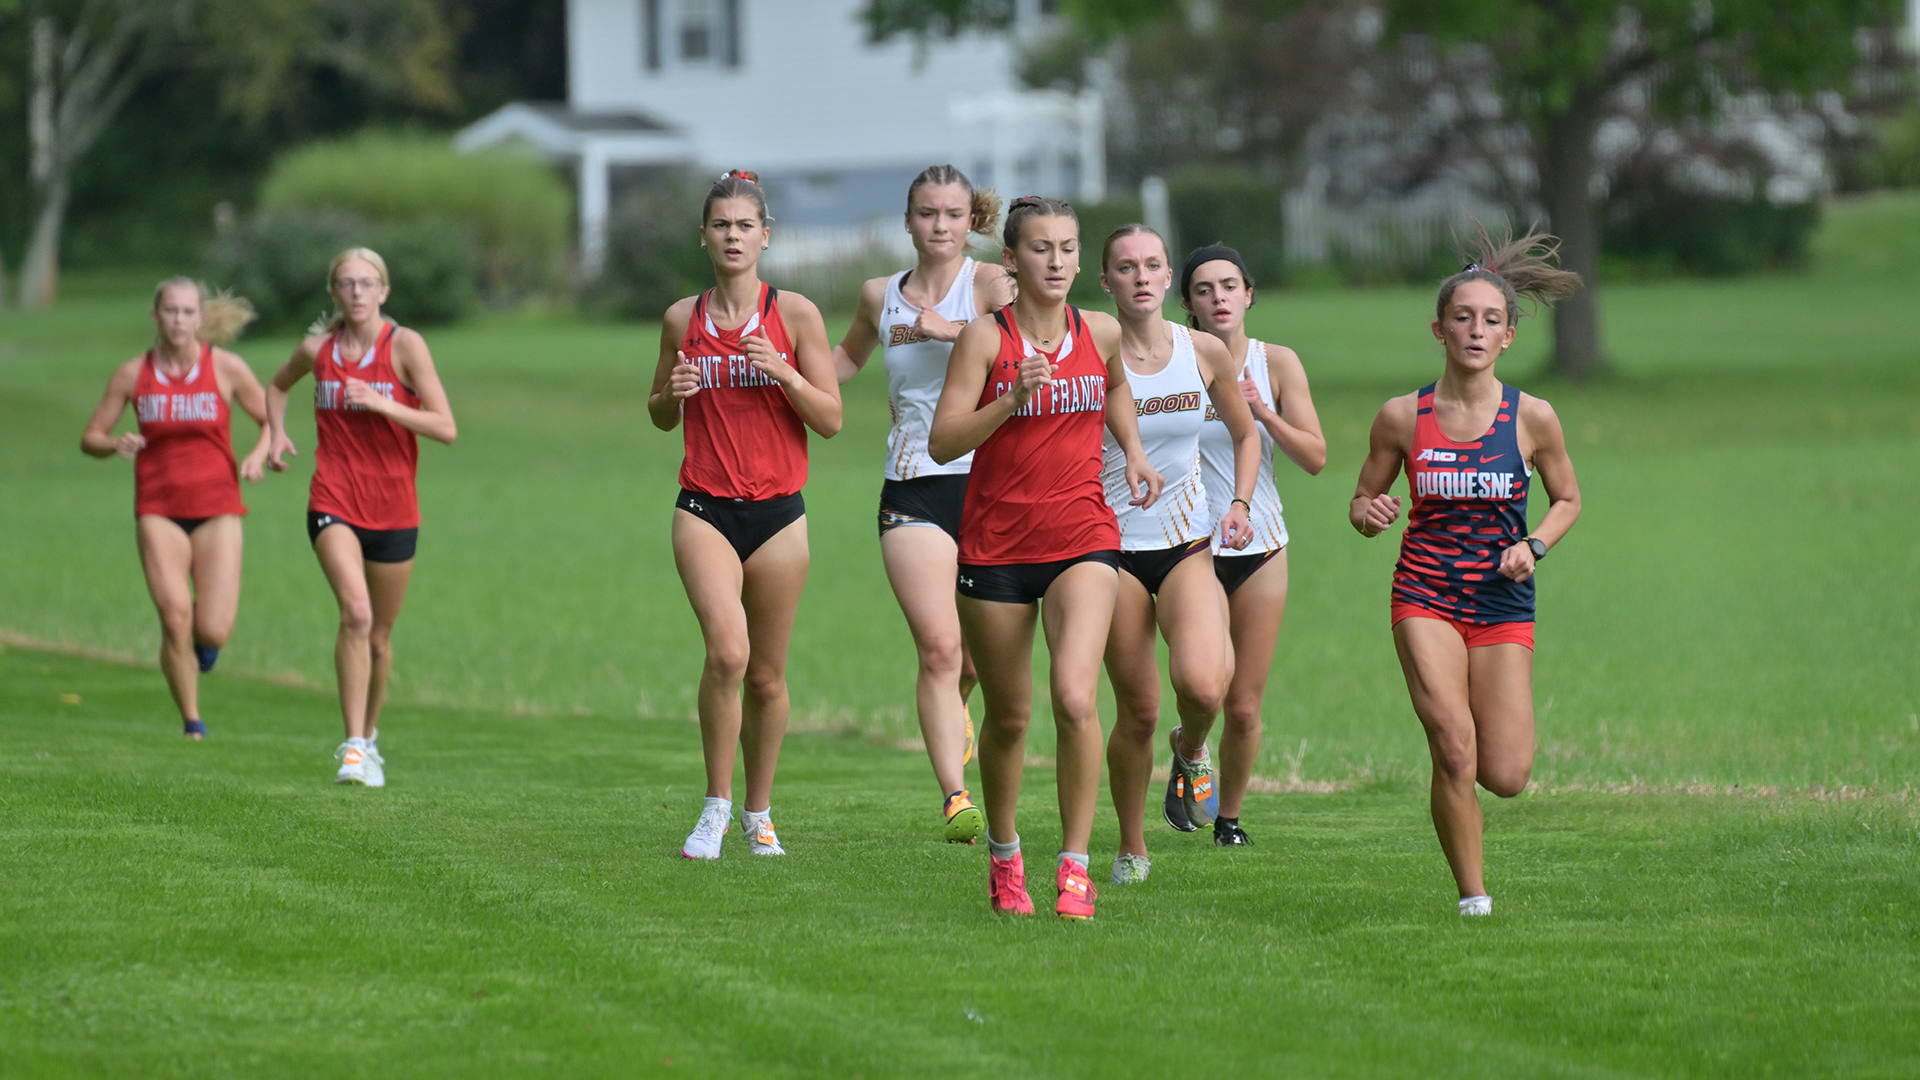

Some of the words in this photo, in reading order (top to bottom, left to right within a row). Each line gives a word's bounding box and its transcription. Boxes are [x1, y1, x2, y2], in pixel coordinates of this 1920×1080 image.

[138, 395, 167, 423] SAINT
[171, 391, 218, 422] FRANCIS
[1133, 391, 1200, 416] LOOM
[1416, 472, 1514, 500] DUQUESNE
